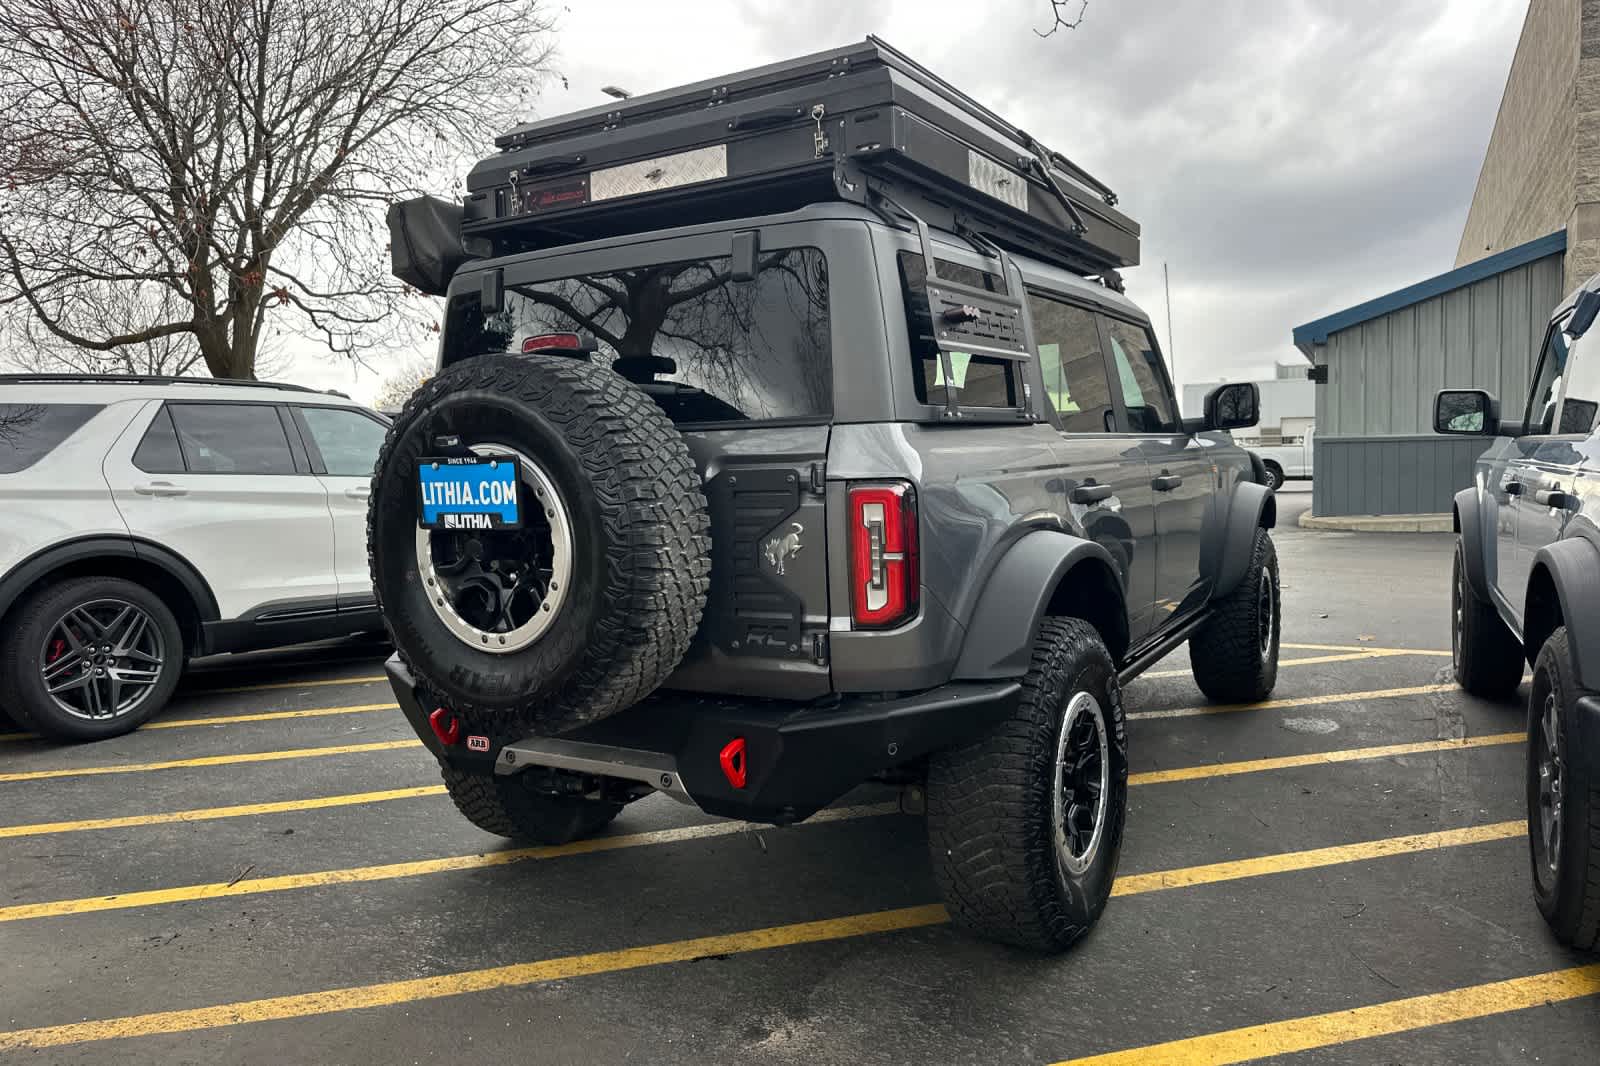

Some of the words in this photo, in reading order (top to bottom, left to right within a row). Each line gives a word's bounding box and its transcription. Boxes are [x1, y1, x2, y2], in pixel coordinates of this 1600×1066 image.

[447, 457, 463, 465] SINCE
[421, 480, 517, 505] LITHIA.COM
[455, 514, 493, 529] LITHIA
[469, 738, 487, 748] ARB
